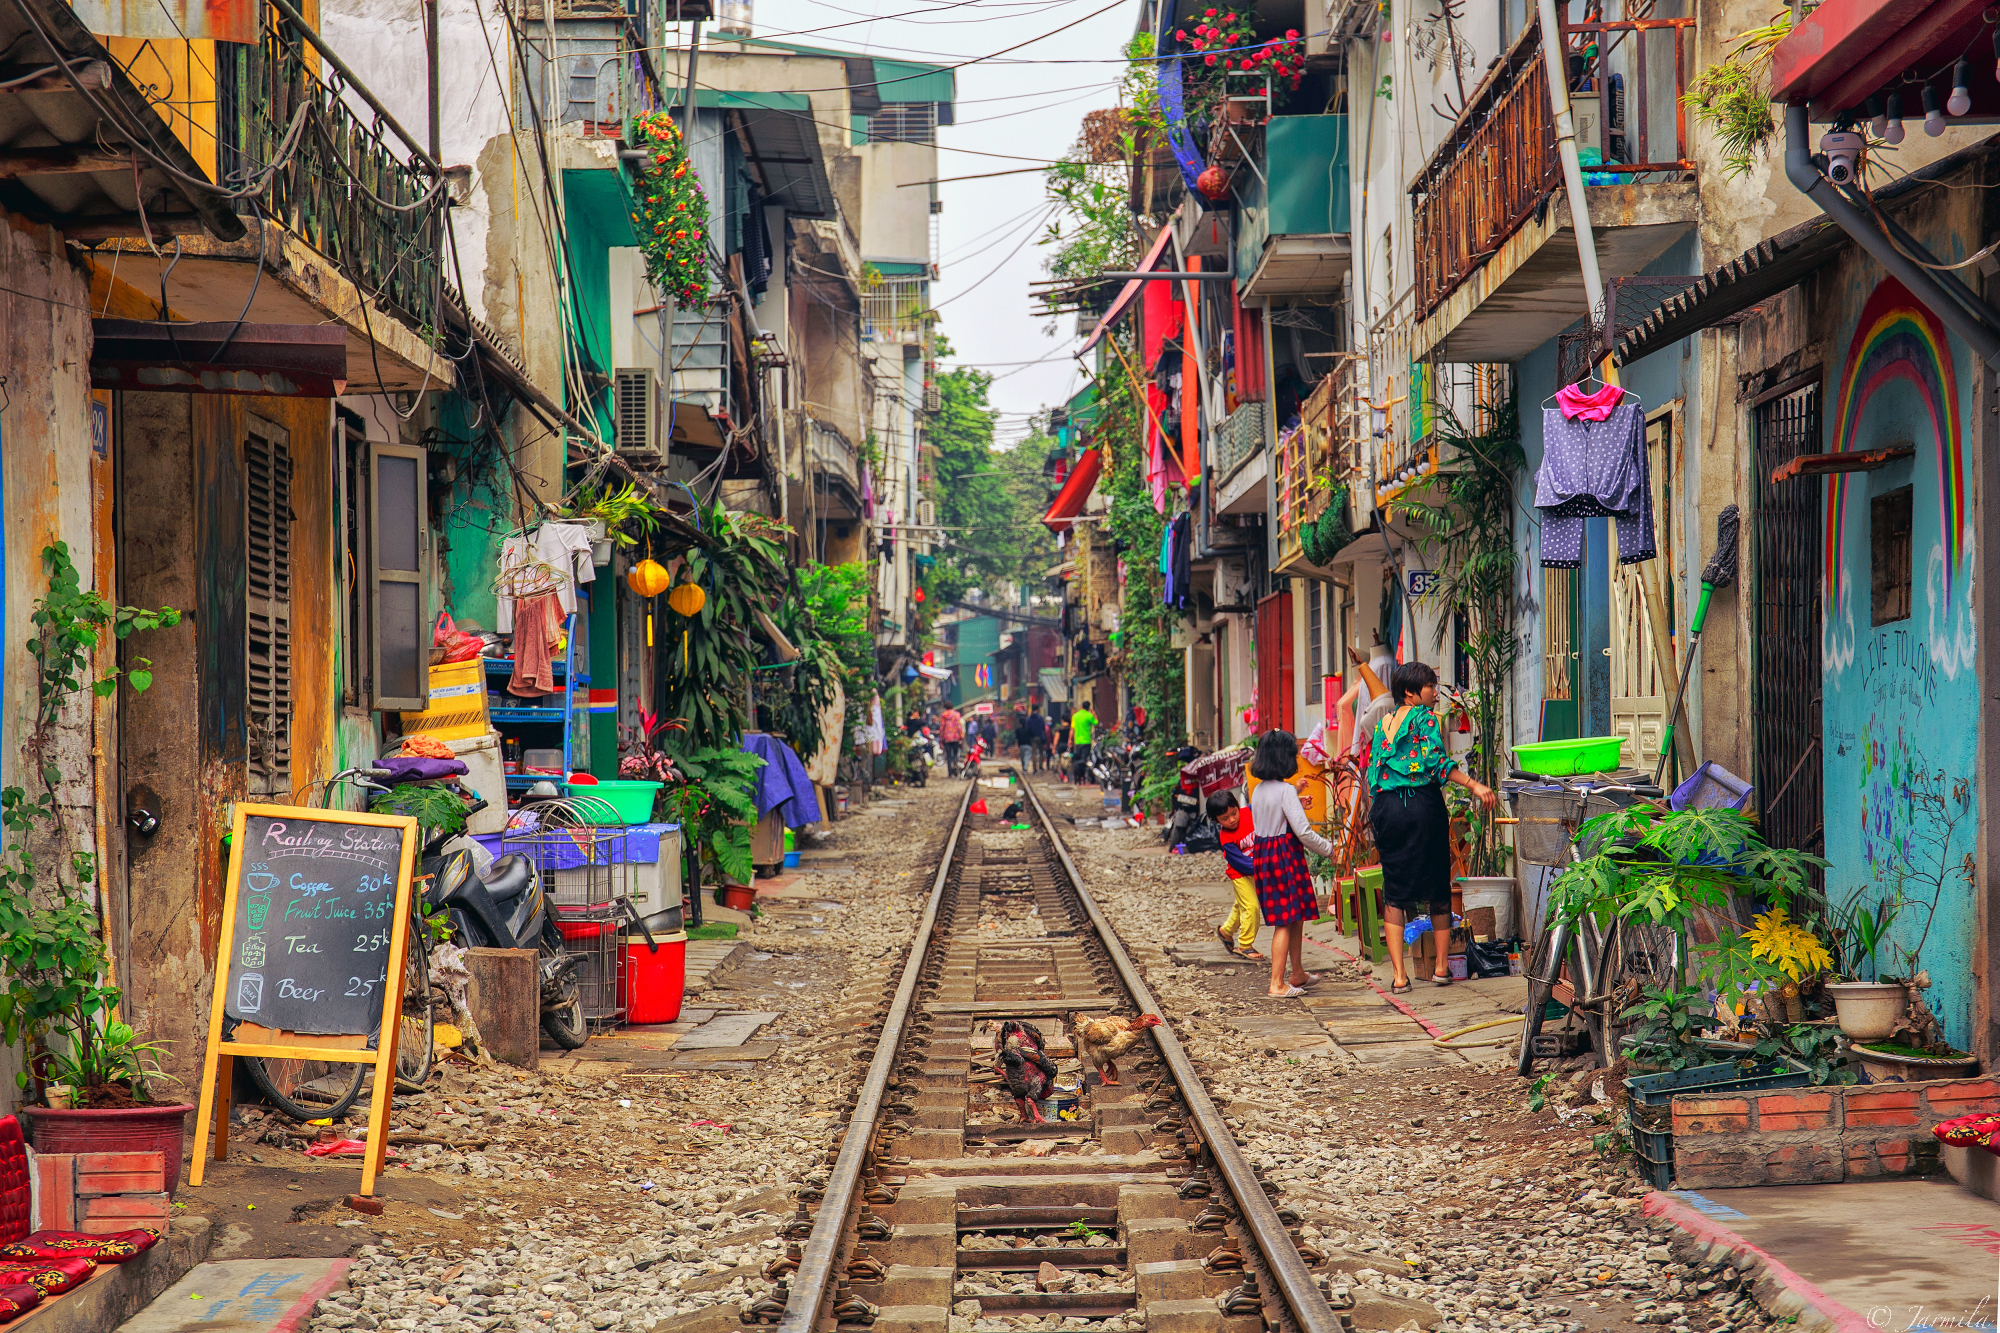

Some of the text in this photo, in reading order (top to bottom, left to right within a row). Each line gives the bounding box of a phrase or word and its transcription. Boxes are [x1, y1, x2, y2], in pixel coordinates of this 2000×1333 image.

[93, 410, 104, 448] 28
[1414, 574, 1435, 592] 35
[1861, 630, 1937, 708] LIVE TO LOVE
[340, 827, 401, 851] Station
[290, 872, 393, 898] Coffee 30k
[284, 898, 322, 922] Fruit
[324, 896, 358, 920] Juice
[284, 927, 390, 955] Tea 25k
[275, 966, 387, 1002] Beer 25k
